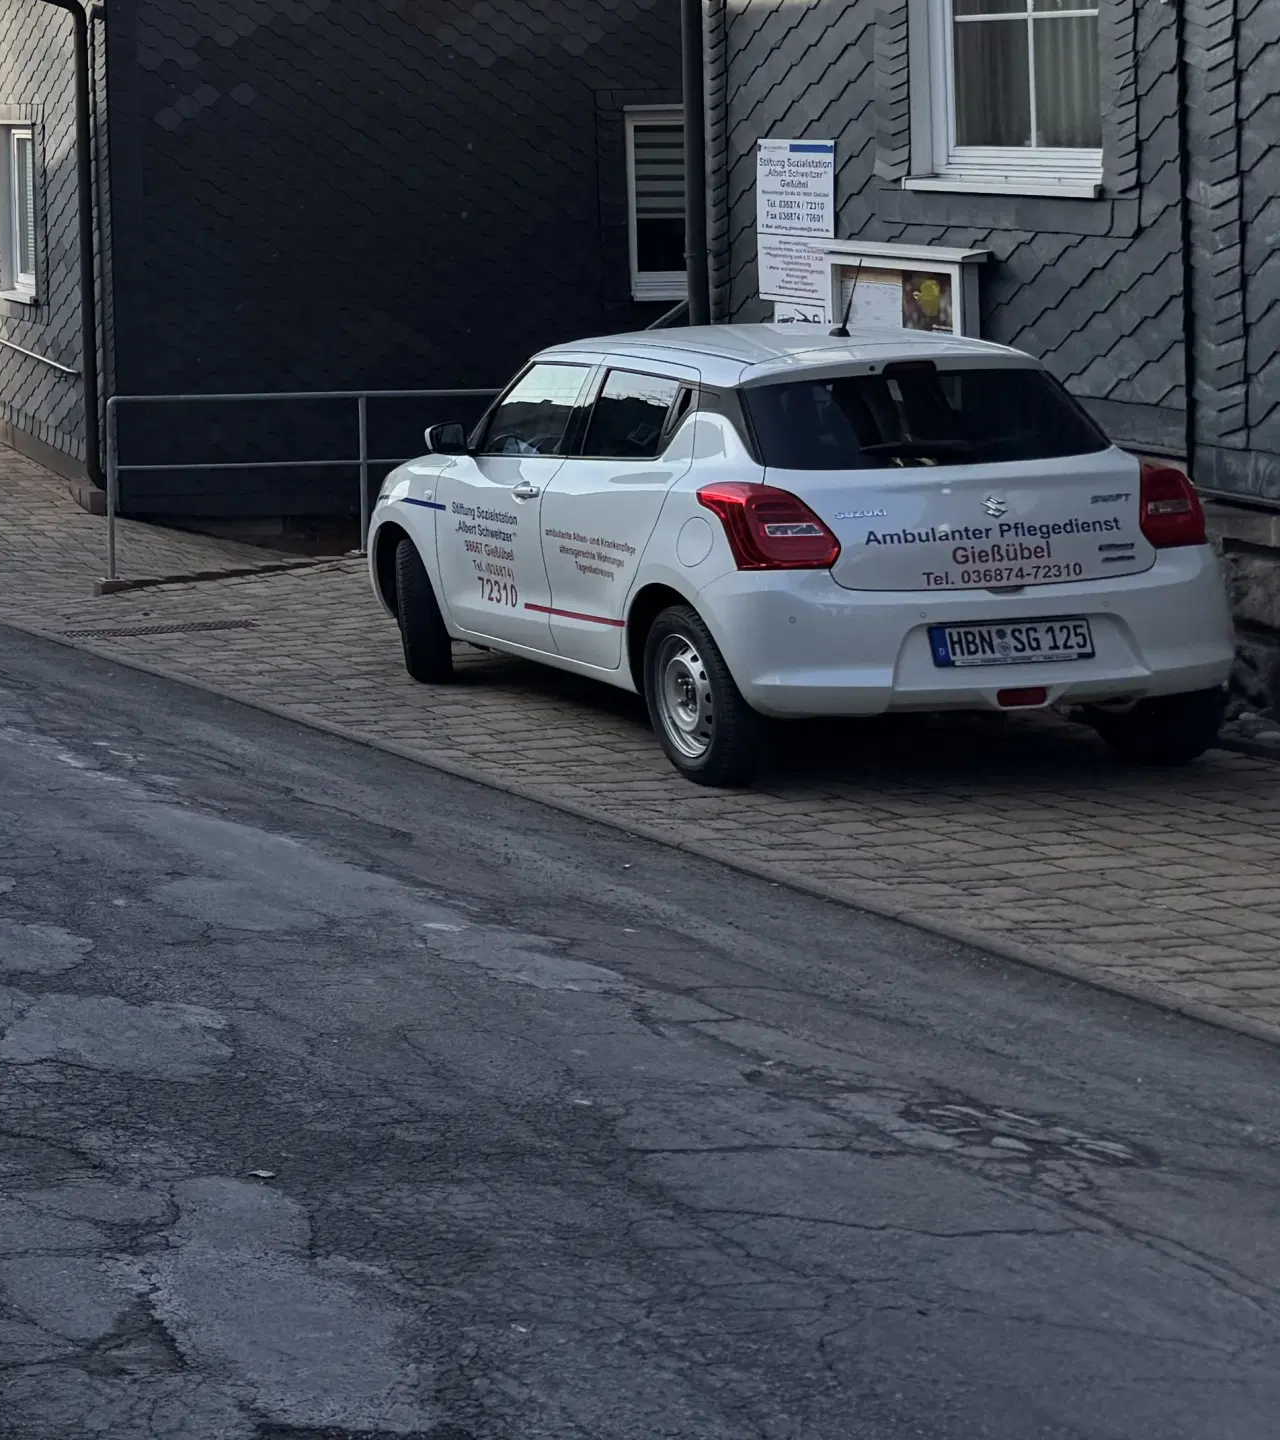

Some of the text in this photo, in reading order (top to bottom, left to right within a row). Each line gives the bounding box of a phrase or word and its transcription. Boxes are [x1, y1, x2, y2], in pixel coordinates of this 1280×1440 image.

[452, 501, 518, 526] Stiftung Sozialstation
[834, 508, 887, 520] SUZUKI
[864, 516, 1121, 546] Ambulanter Pflegedienst
[484, 544, 515, 562] Gießübel
[951, 541, 1052, 565] Gießübel
[923, 563, 1083, 587] Tel. 036874-72310
[477, 576, 518, 608] 72310
[948, 624, 1088, 657] HBN SG 125
